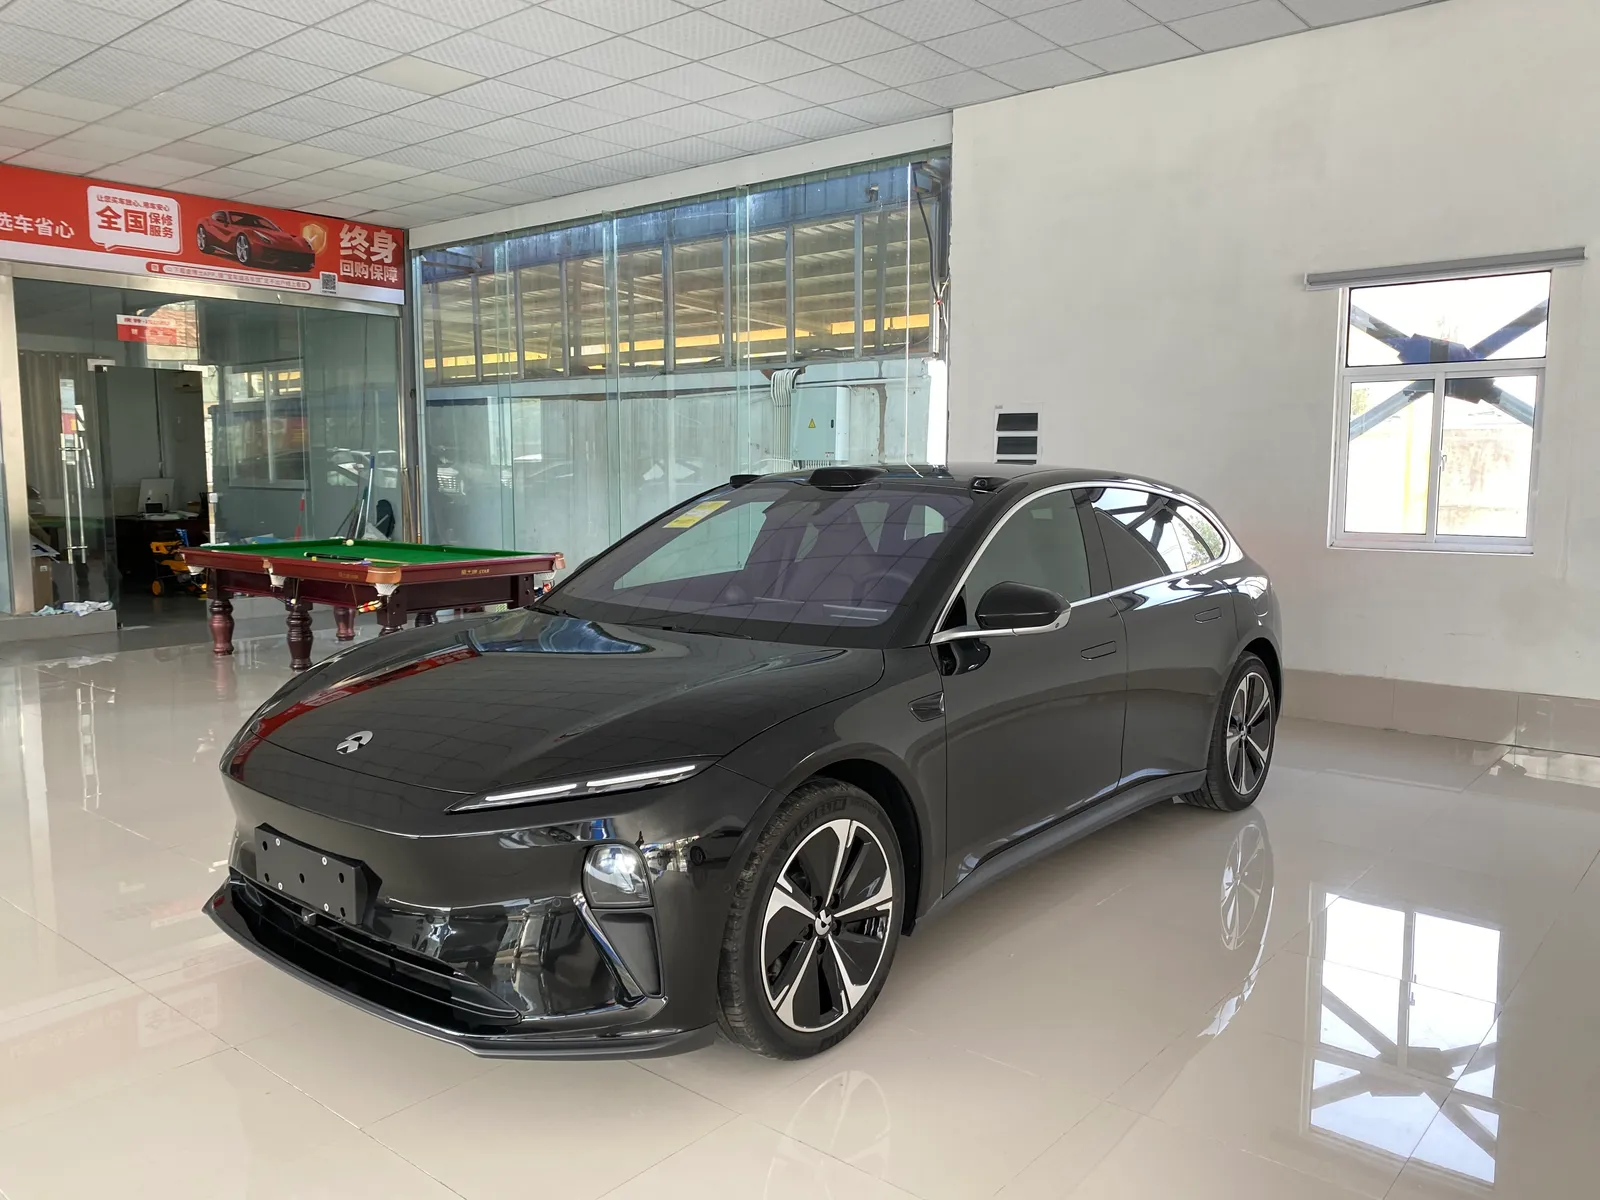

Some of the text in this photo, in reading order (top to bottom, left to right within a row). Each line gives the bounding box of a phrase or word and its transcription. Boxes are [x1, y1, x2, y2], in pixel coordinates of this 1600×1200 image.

[0, 212, 75, 238] 选车省心
[95, 205, 148, 235] 全国
[149, 212, 173, 226] 保修
[149, 224, 174, 238] 服务
[339, 223, 397, 263] 终身
[339, 259, 398, 283] 回购保障
